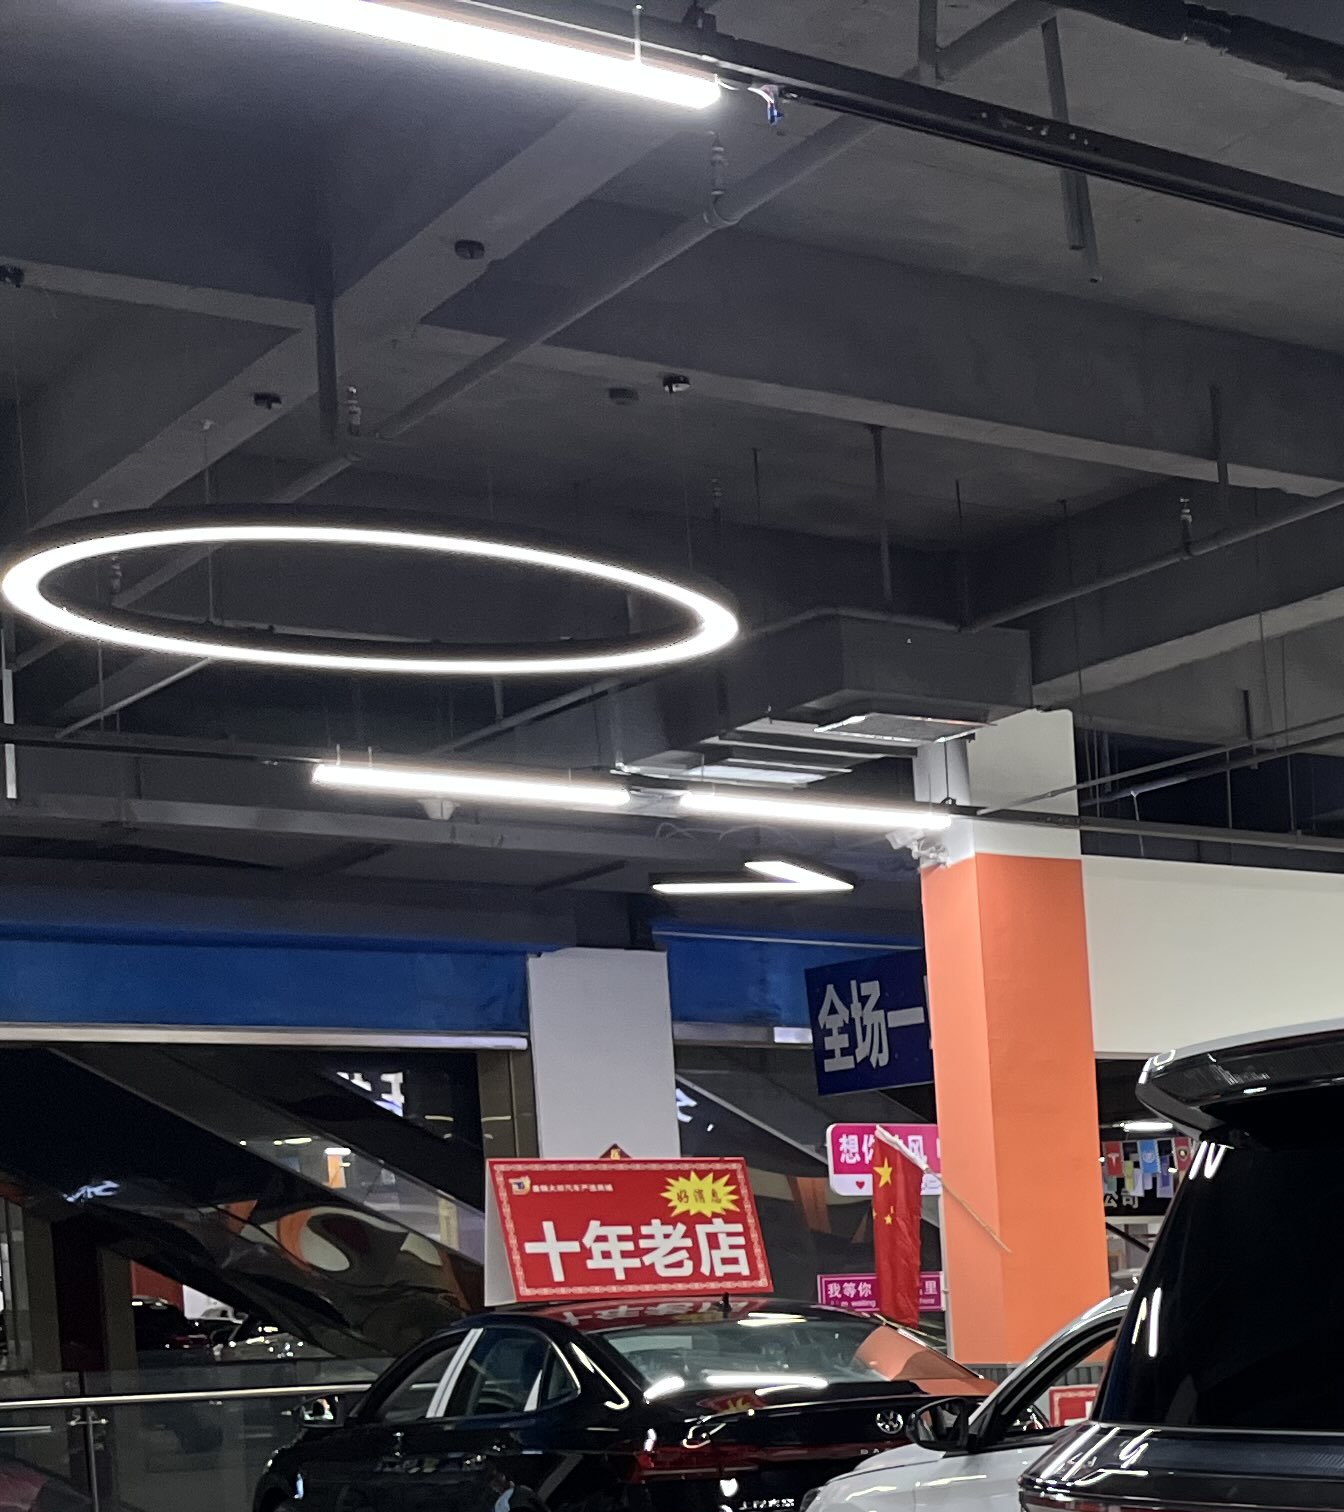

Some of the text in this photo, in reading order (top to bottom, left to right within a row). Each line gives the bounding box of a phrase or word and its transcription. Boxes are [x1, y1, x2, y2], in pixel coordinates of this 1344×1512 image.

[818, 978, 932, 1073] 全场一
[524, 1218, 750, 1282] 十年老店
